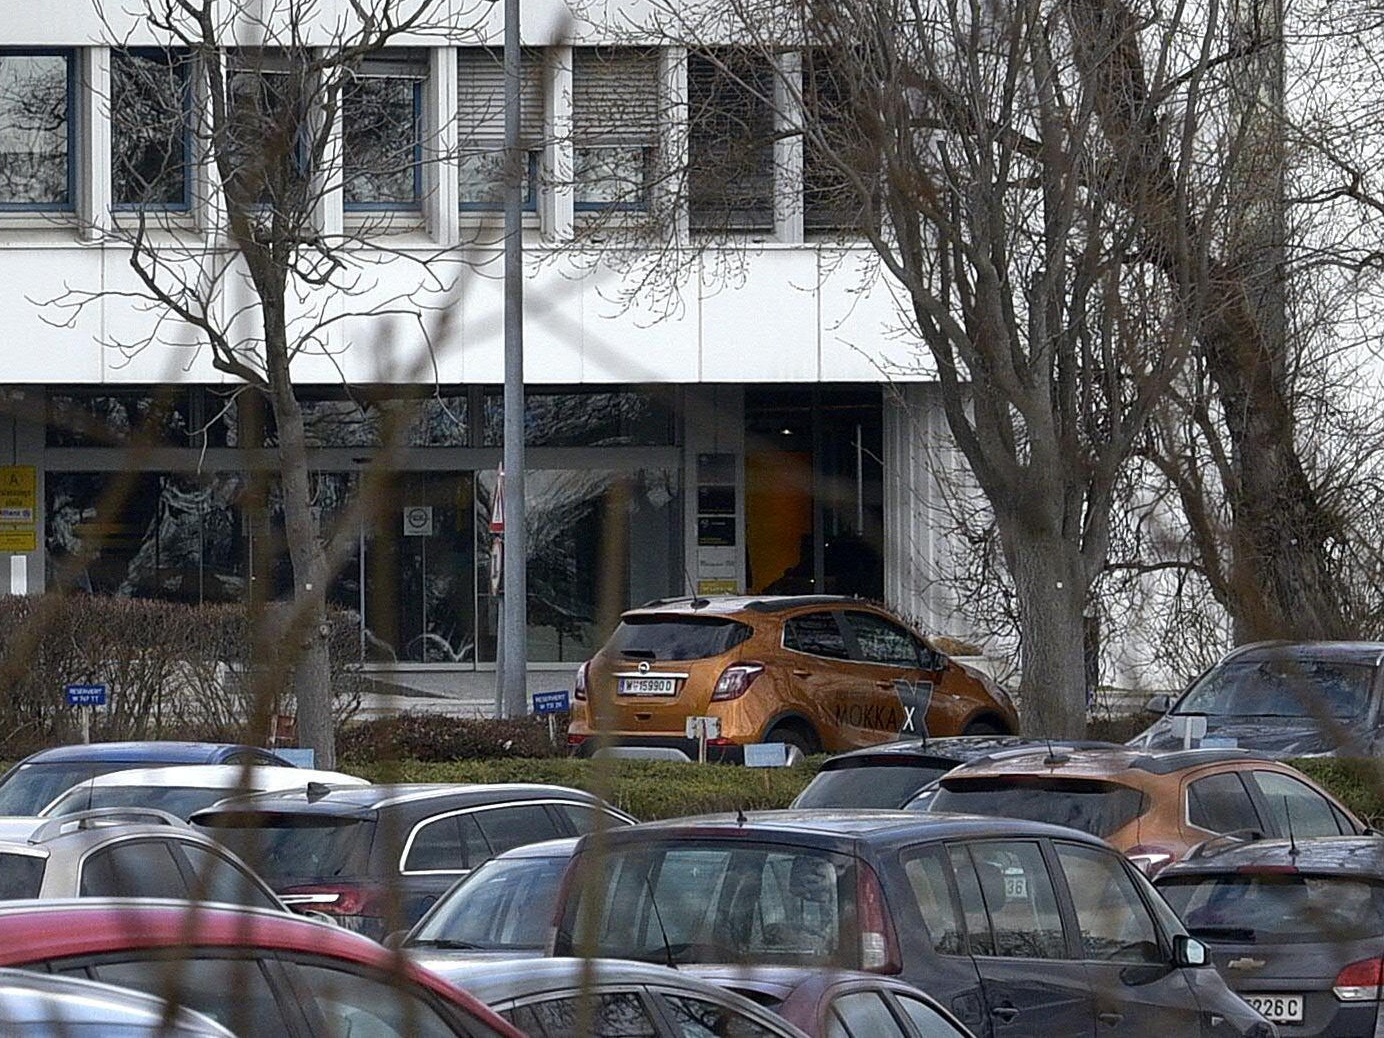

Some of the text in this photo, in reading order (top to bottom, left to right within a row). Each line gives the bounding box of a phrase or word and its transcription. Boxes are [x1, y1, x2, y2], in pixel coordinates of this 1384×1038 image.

[835, 704, 915, 731] MOKKA X
[1244, 999, 1298, 1016] 226 C
